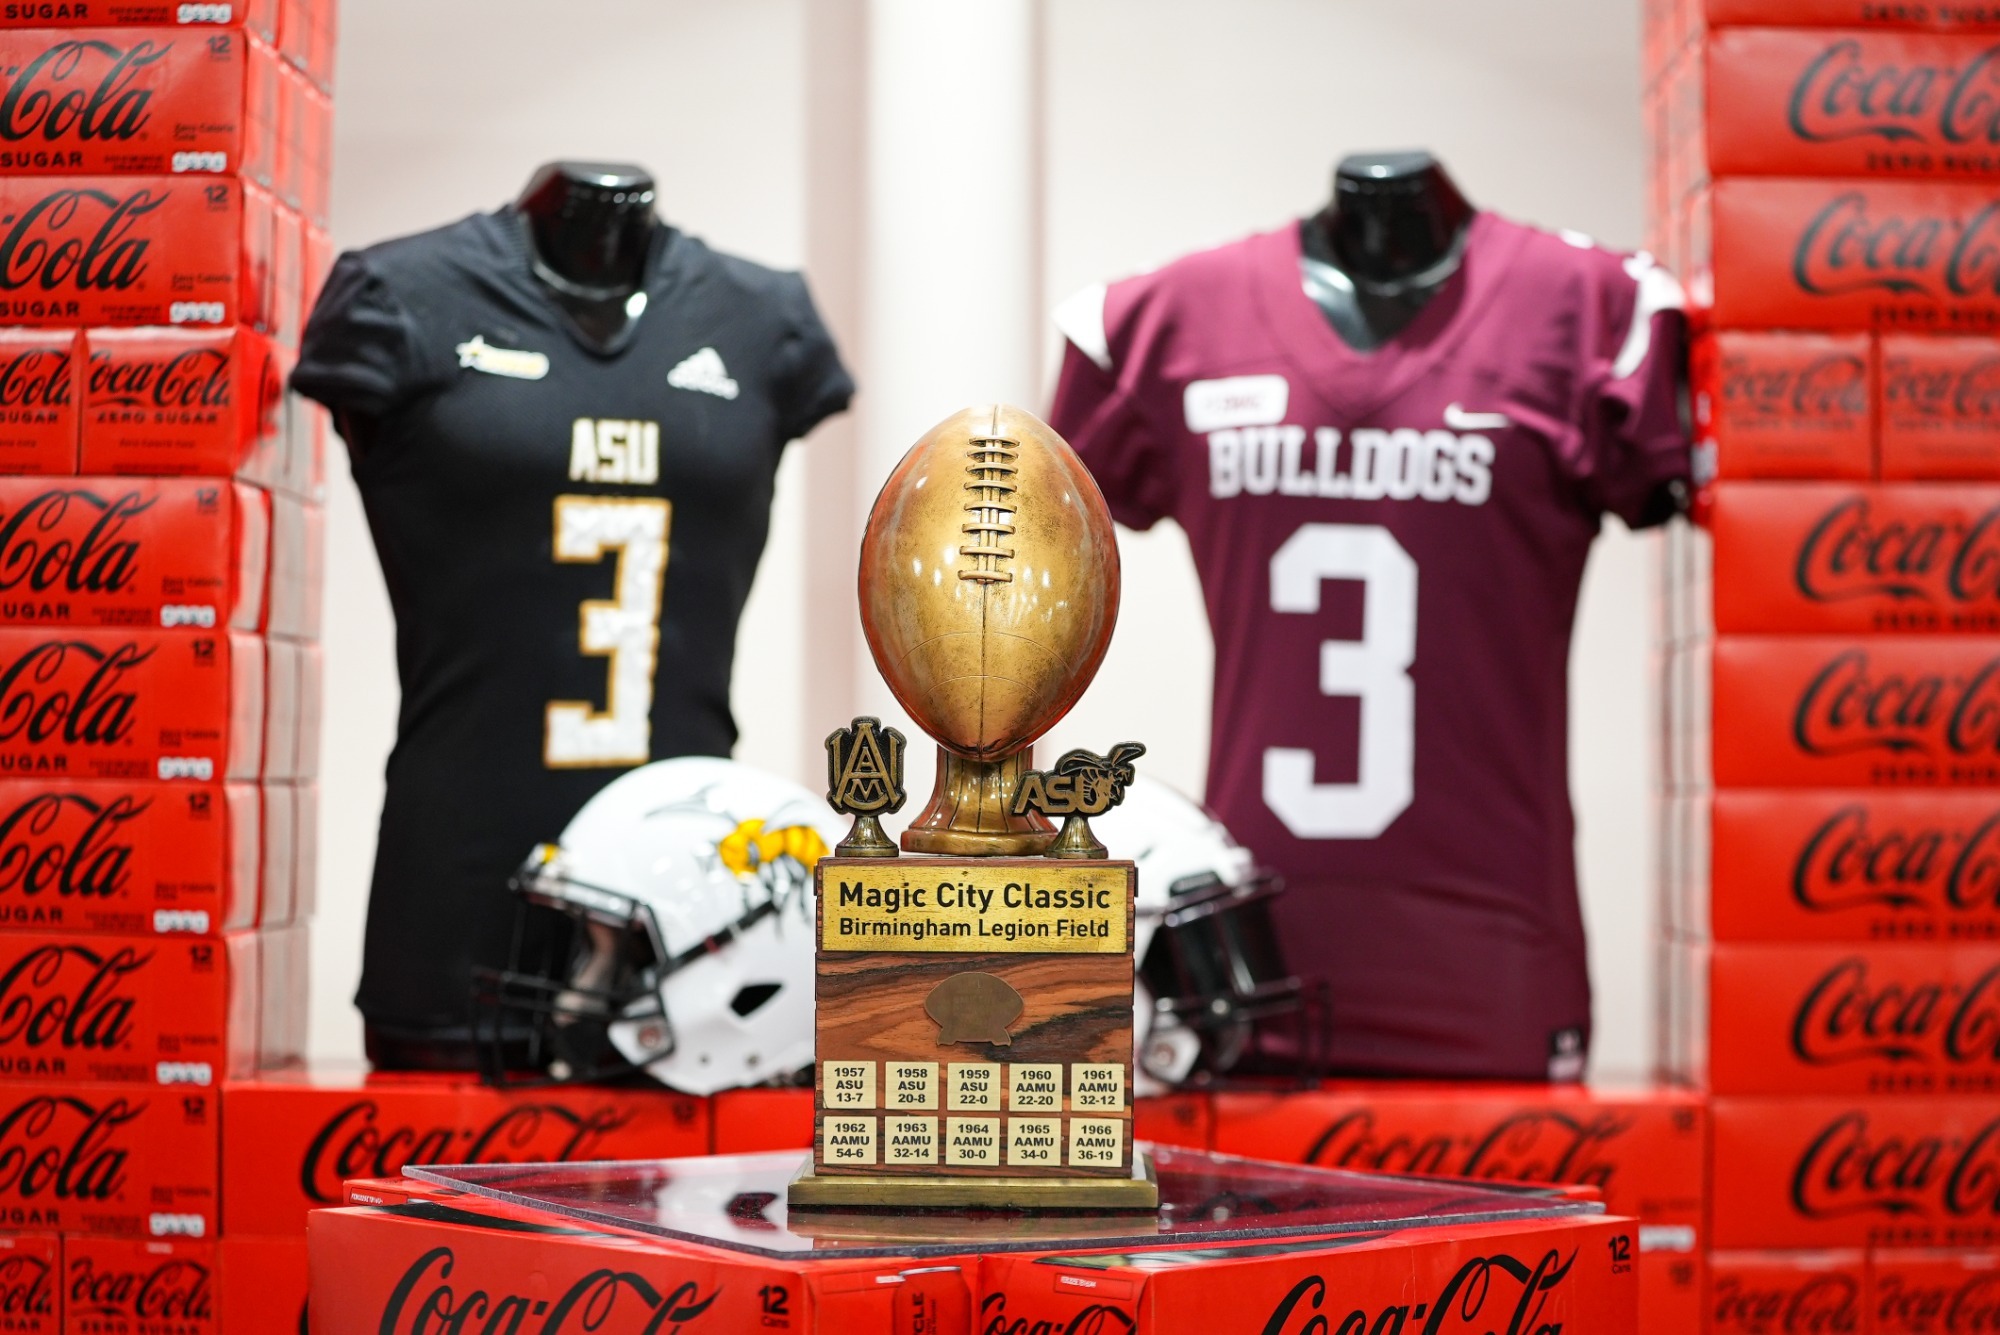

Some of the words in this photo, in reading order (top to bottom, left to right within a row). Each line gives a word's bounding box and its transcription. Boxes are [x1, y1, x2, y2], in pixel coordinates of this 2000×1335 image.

[5, 4, 88, 19] SUGAR
[569, 418, 660, 485] ASU
[1208, 425, 1495, 506] BULLDOGS
[544, 494, 672, 768] 3
[1262, 523, 1419, 839] 3
[839, 881, 926, 913] Magic
[936, 882, 994, 912] City
[1003, 883, 1111, 909] Classic
[839, 917, 971, 940] Birmingham
[979, 918, 1049, 941] Legion
[1057, 919, 1109, 938] Field
[834, 1067, 866, 1077] 1957
[896, 1068, 928, 1078] 1958
[958, 1069, 990, 1079] 1959
[1020, 1070, 1052, 1080] 1960
[1082, 1070, 1112, 1080] 1961
[835, 1079, 864, 1090] ASU
[897, 1080, 926, 1091] ASU
[959, 1081, 988, 1092] ASU
[1015, 1082, 1056, 1093] AAMU
[1077, 1082, 1118, 1093] AAMU
[836, 1092, 864, 1103] 13-7
[897, 1093, 926, 1104] 20-8
[959, 1094, 988, 1105] 22-0
[1017, 1095, 1054, 1106] 22-20
[1080, 1095, 1116, 1105] 32-12
[834, 1123, 866, 1133] 1962
[896, 1123, 927, 1133] 1963
[958, 1124, 989, 1134] 1964
[1019, 1124, 1050, 1134] 1965
[1081, 1124, 1112, 1135] 1966
[829, 1135, 870, 1146] AAMU
[891, 1135, 931, 1146] AAMU
[952, 1136, 993, 1147] AAMU
[1014, 1136, 1054, 1147] AAMU
[1076, 1137, 1116, 1148] AAMU
[836, 1148, 864, 1158] 54-6
[894, 1147, 930, 1158] 32-14
[959, 1148, 987, 1160] 30-0
[1020, 1149, 1048, 1160] 34-0
[1078, 1150, 1113, 1161] 36-19
[1608, 1235, 1631, 1262] 12
[1612, 1263, 1631, 1275] Cans
[758, 1285, 789, 1315] 12
